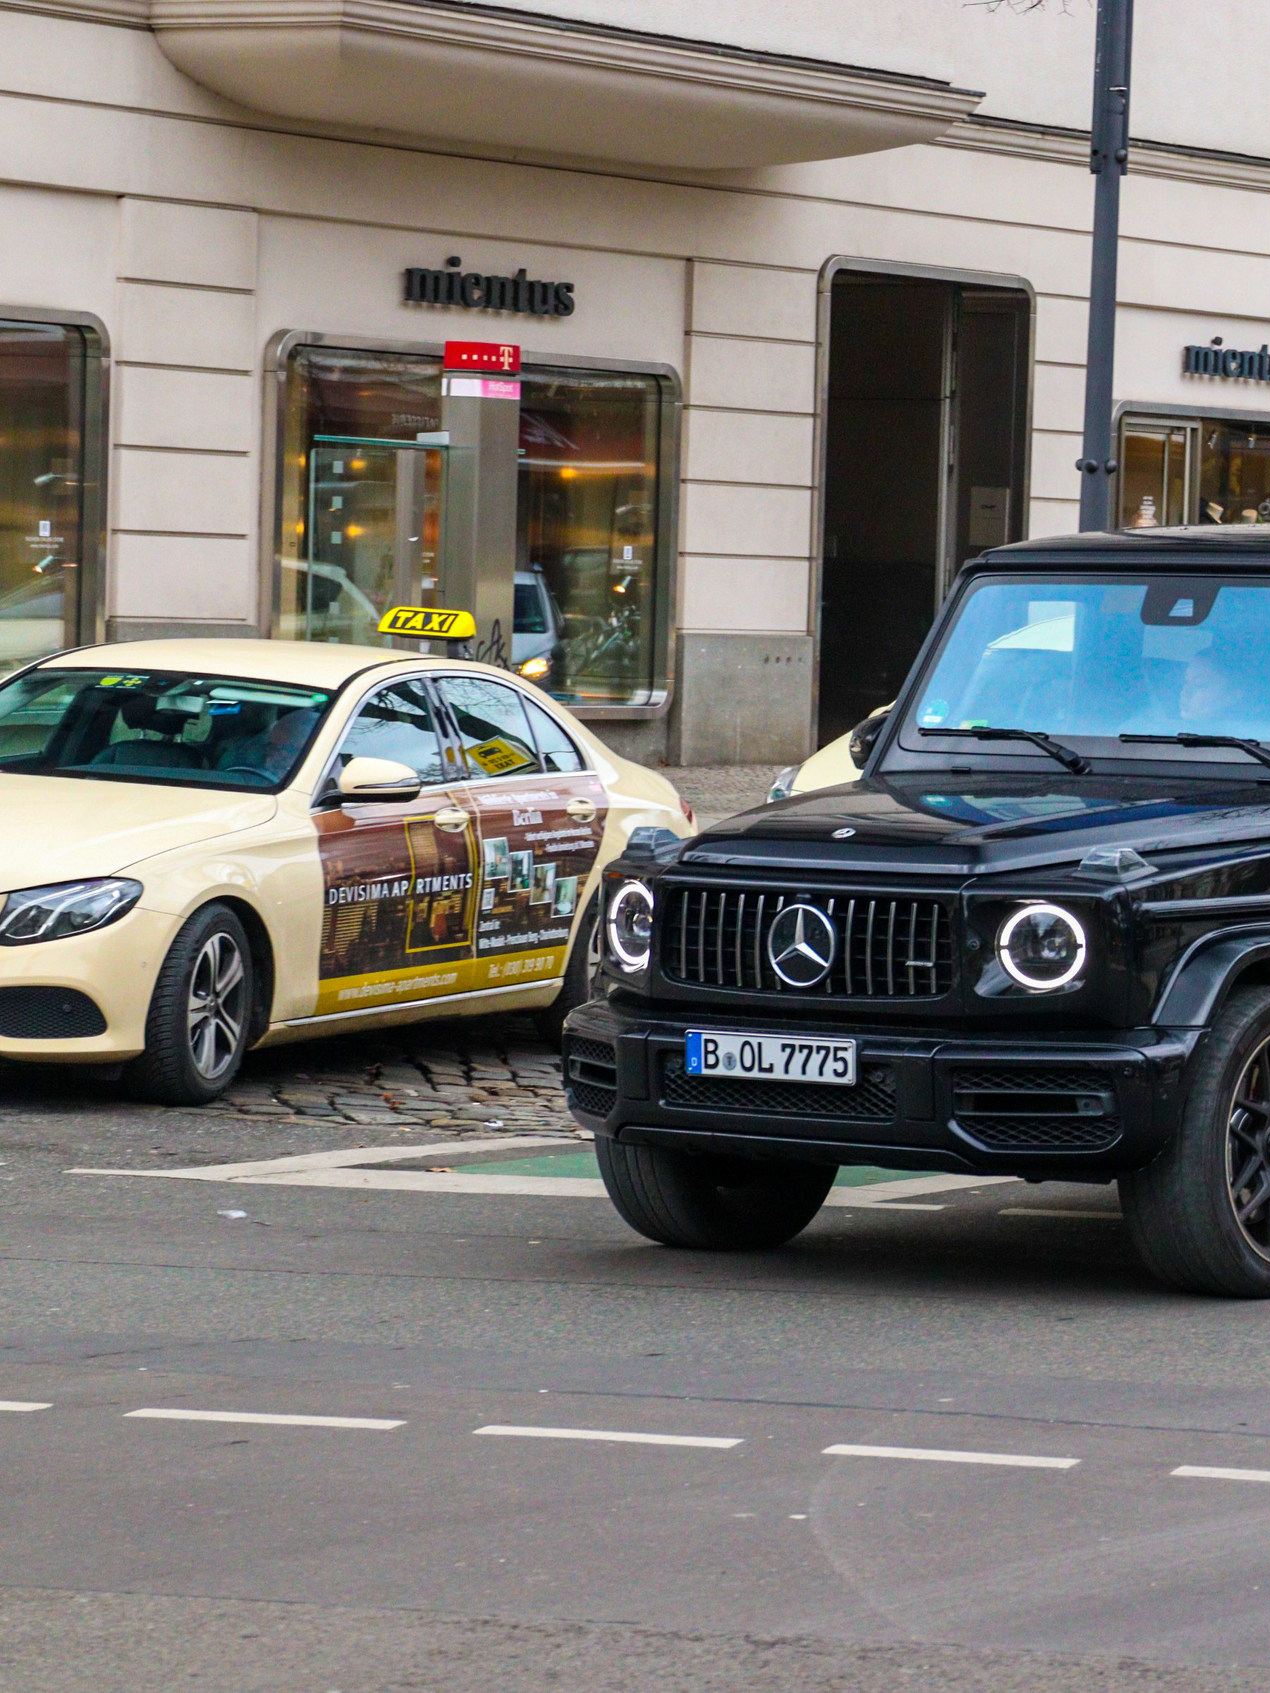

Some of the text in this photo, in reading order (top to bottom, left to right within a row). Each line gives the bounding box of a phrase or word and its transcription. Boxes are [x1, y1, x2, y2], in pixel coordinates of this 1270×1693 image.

[404, 255, 575, 316] mientus
[394, 611, 456, 632] TAXI
[329, 882, 389, 905] DEVISIMA
[703, 1038, 849, 1078] B OL 7775
